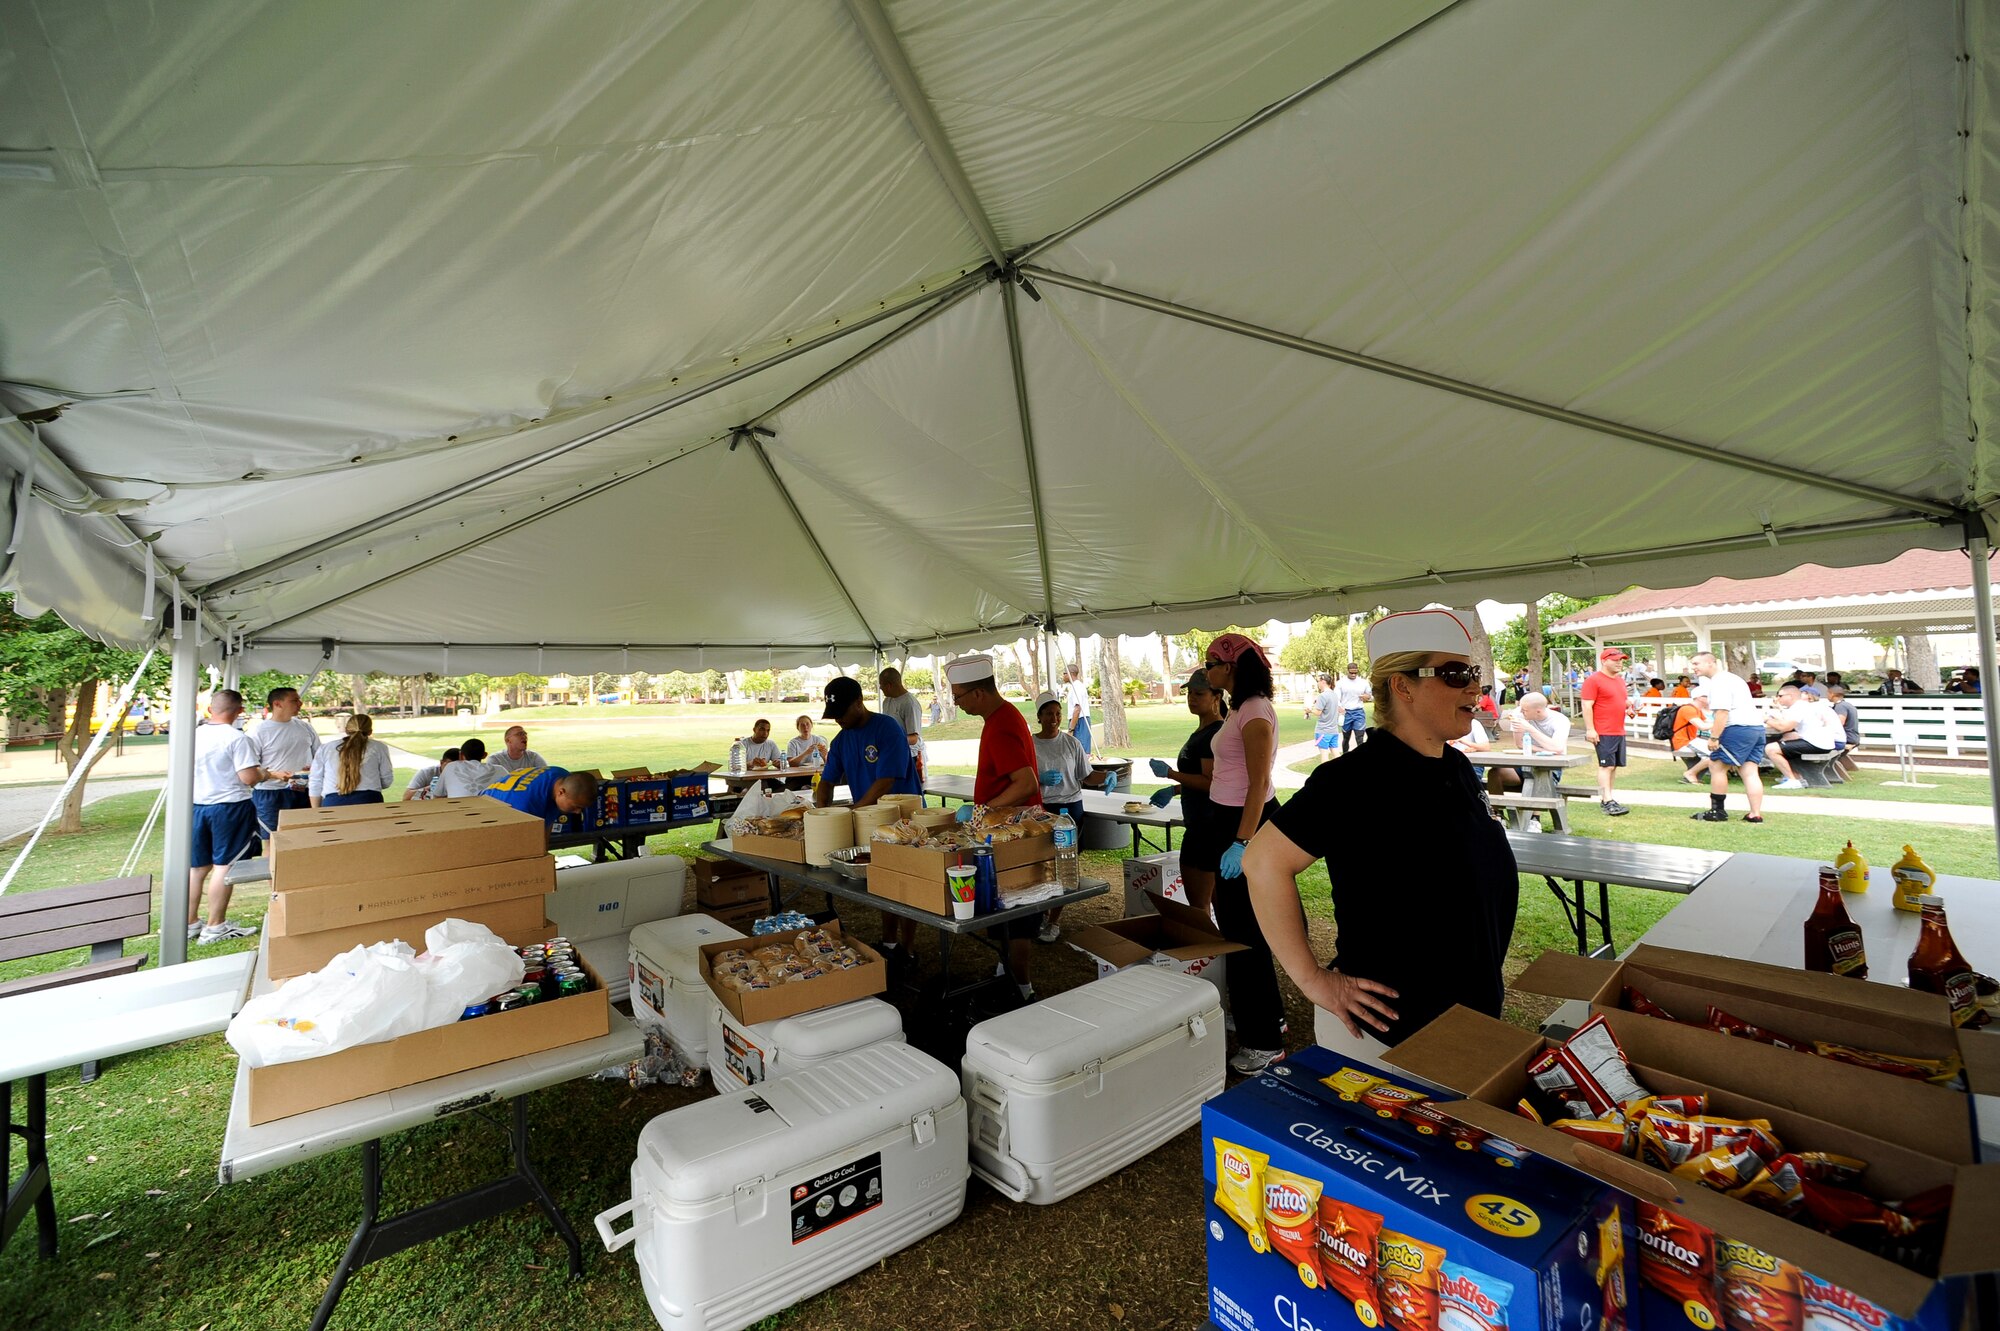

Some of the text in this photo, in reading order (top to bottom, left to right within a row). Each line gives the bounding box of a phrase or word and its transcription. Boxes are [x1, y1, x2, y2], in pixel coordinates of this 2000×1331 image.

[1164, 875, 1184, 899] SYS
[1278, 1085, 1320, 1107] Recyclable
[1373, 1086, 1412, 1101] Fritos
[1289, 1122, 1450, 1206] Classic Mix
[814, 1174, 834, 1188] Quick
[840, 1164, 856, 1176] Cool
[1265, 1184, 1308, 1214] Fritos
[1476, 1211, 1511, 1232] Singles
[1479, 1198, 1532, 1227] 45
[1251, 1235, 1261, 1247] 10
[1319, 1227, 1368, 1268] Doritos
[1301, 1267, 1313, 1282] 10
[1438, 1271, 1500, 1317] Ruffles
[1359, 1304, 1373, 1321] 10
[1689, 1306, 1709, 1324] 10
